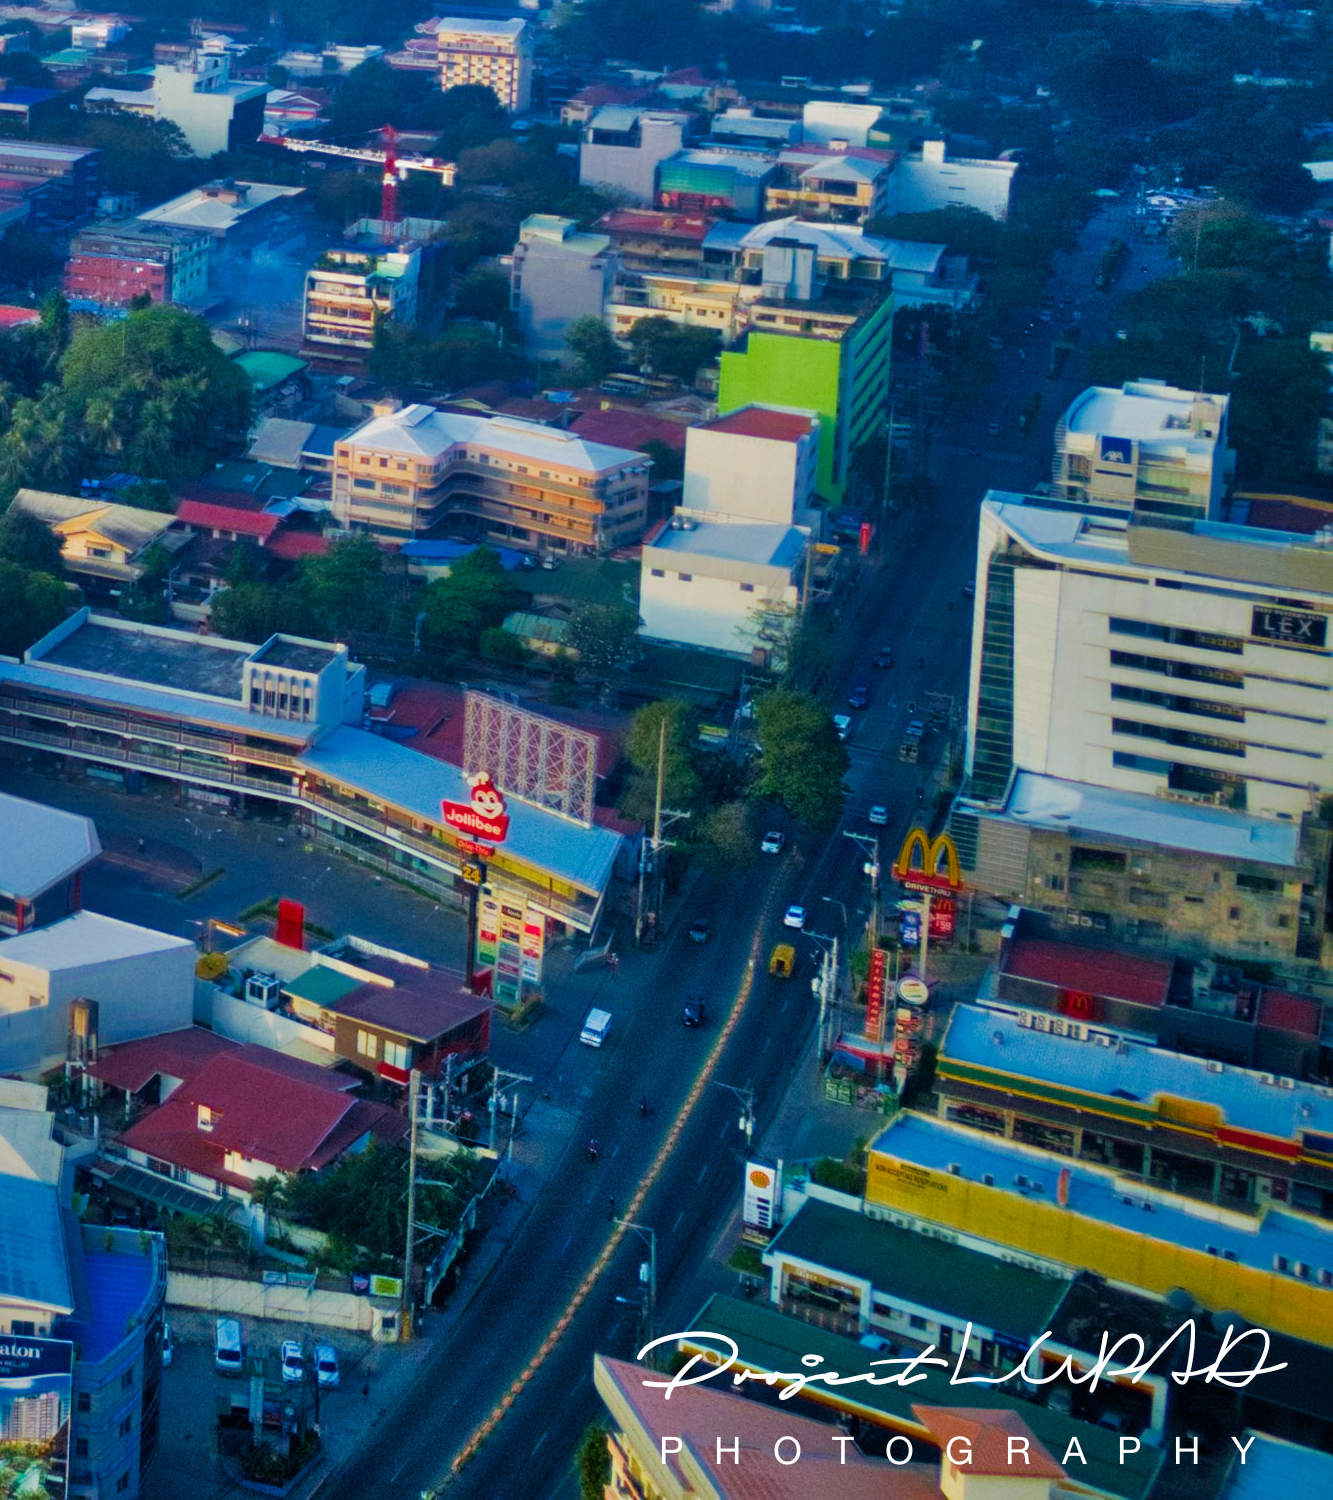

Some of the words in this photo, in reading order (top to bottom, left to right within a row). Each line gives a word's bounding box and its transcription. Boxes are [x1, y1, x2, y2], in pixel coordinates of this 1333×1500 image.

[1102, 451, 1124, 462] AXA
[1265, 614, 1312, 637] LEX
[446, 808, 501, 836] Jollibee
[463, 865, 481, 883] 24
[903, 929, 918, 940] 24
